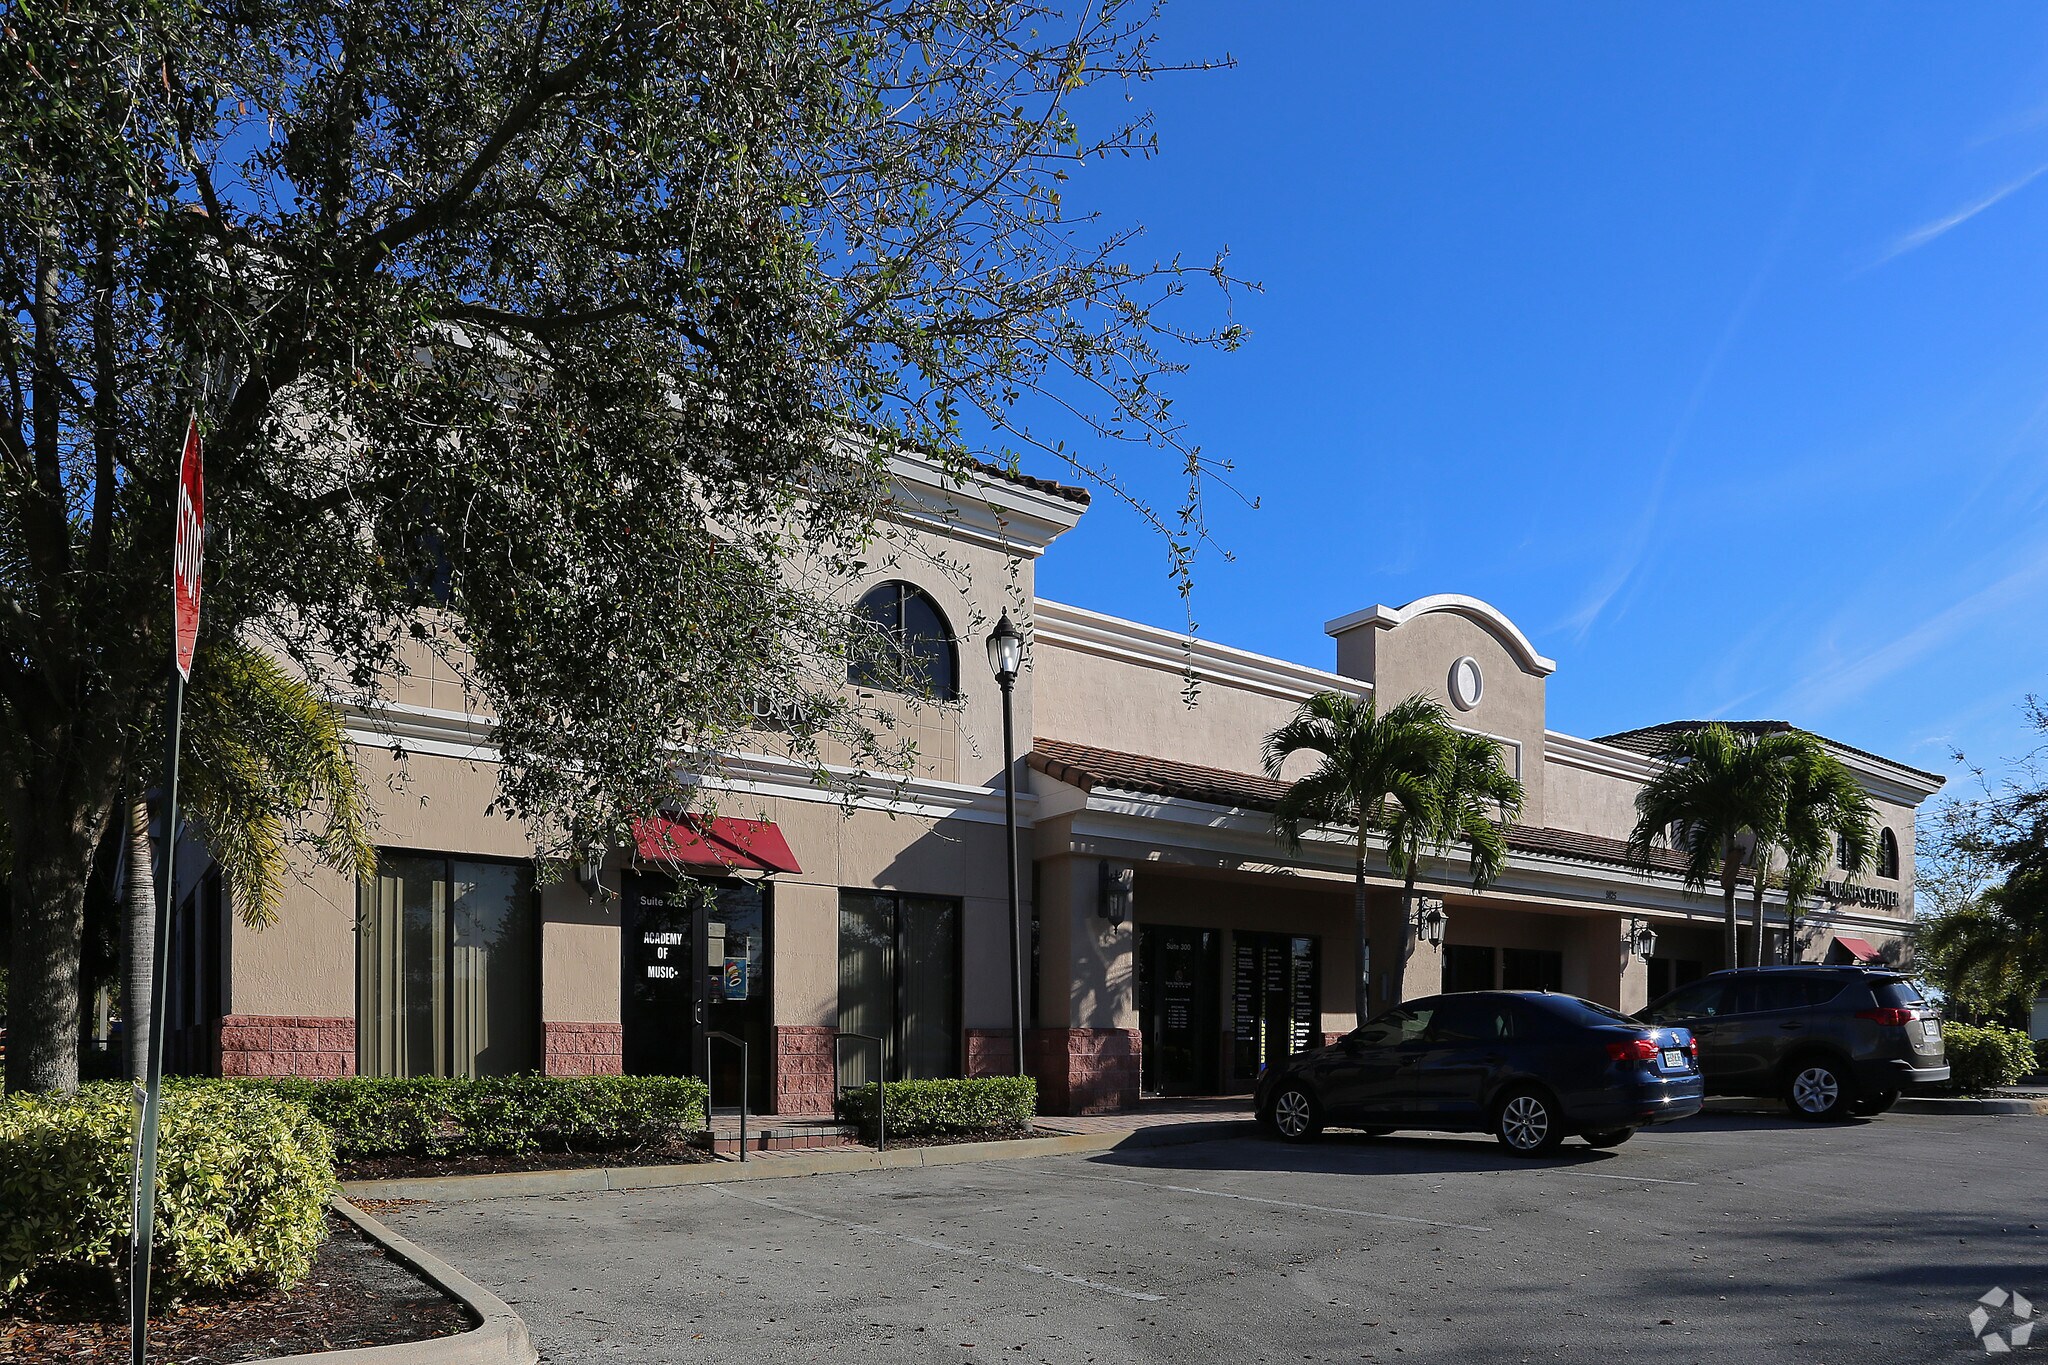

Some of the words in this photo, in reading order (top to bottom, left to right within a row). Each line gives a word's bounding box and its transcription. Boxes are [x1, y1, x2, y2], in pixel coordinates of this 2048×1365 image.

[178, 482, 201, 607] STOP
[640, 896, 664, 906] Suite
[1868, 887, 1899, 907] CENTER
[643, 931, 683, 945] ACADEMY
[657, 946, 669, 960] OF
[1166, 942, 1179, 950] Suite
[1180, 943, 1191, 951] 300
